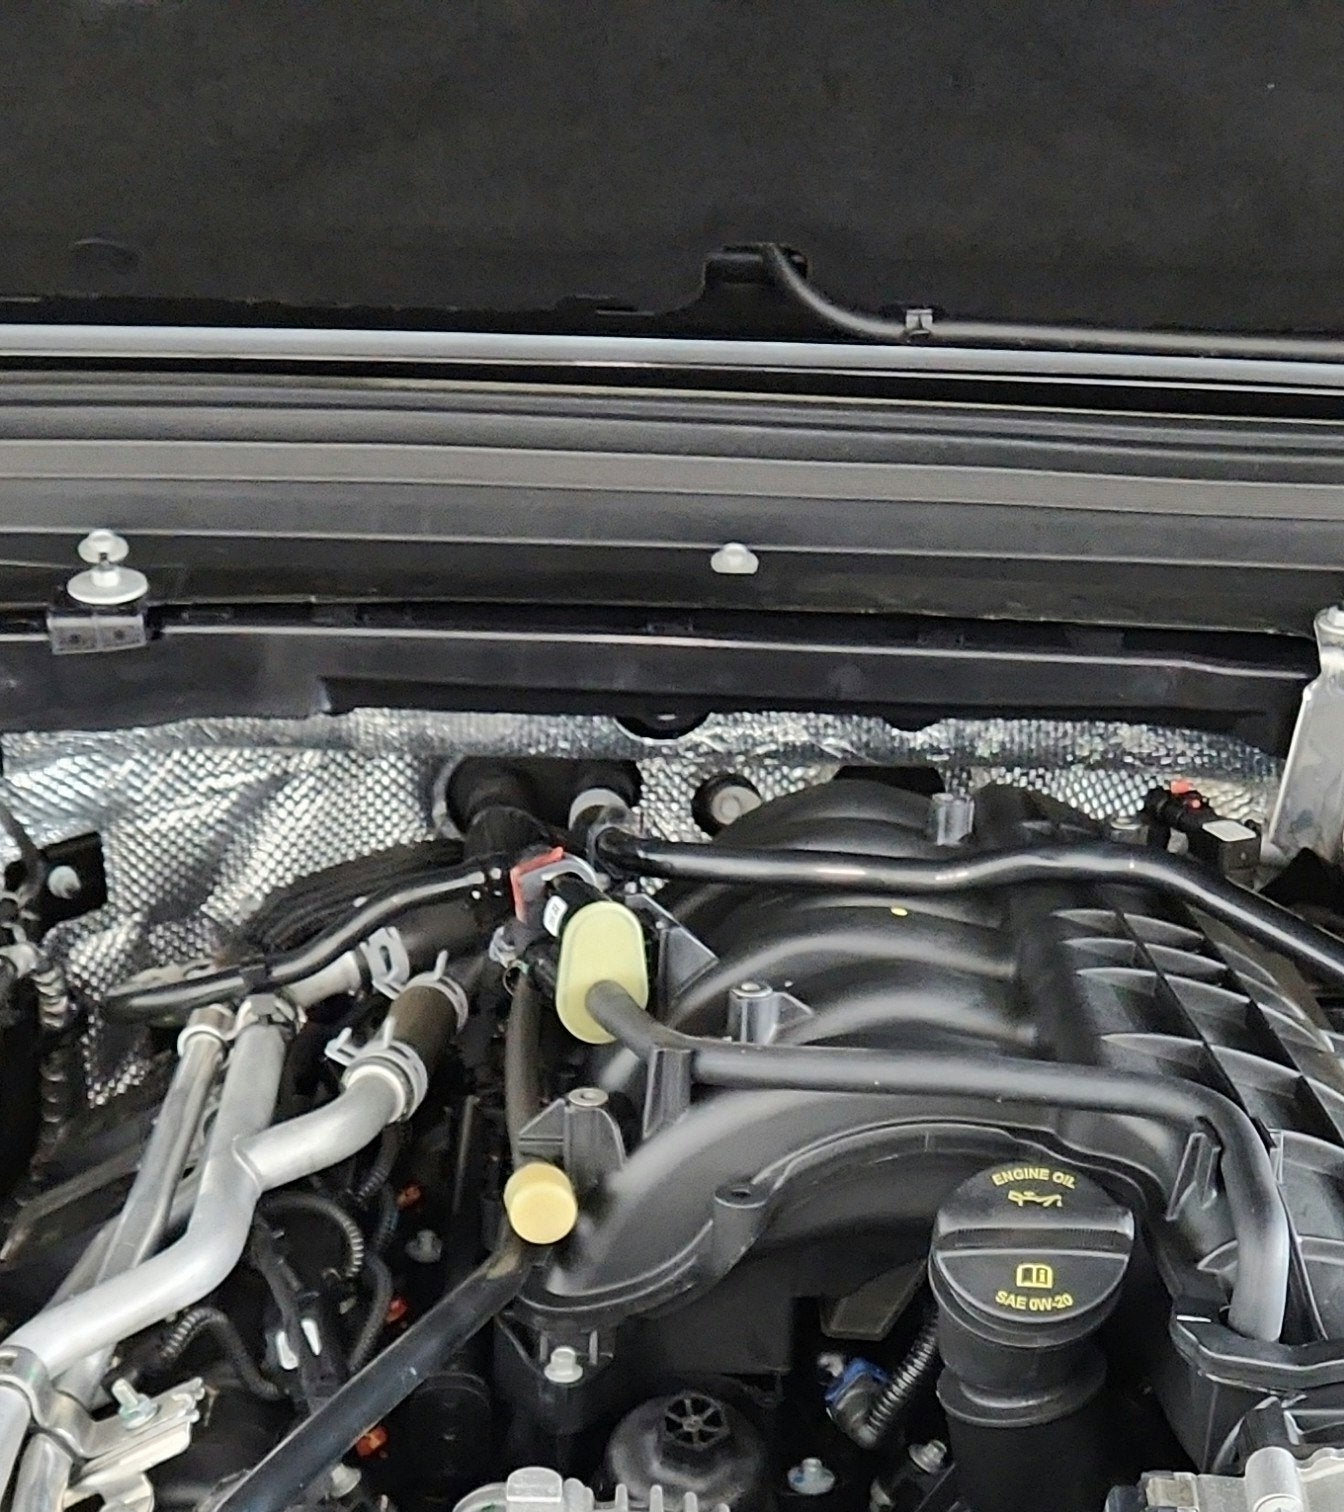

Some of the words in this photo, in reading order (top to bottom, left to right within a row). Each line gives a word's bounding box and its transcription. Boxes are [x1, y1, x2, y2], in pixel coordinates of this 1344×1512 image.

[991, 1167, 1050, 1186] ENGINE
[1052, 1171, 1076, 1190] OIL
[995, 1290, 1026, 1309] SAE
[1029, 1293, 1073, 1311] 0W-20
